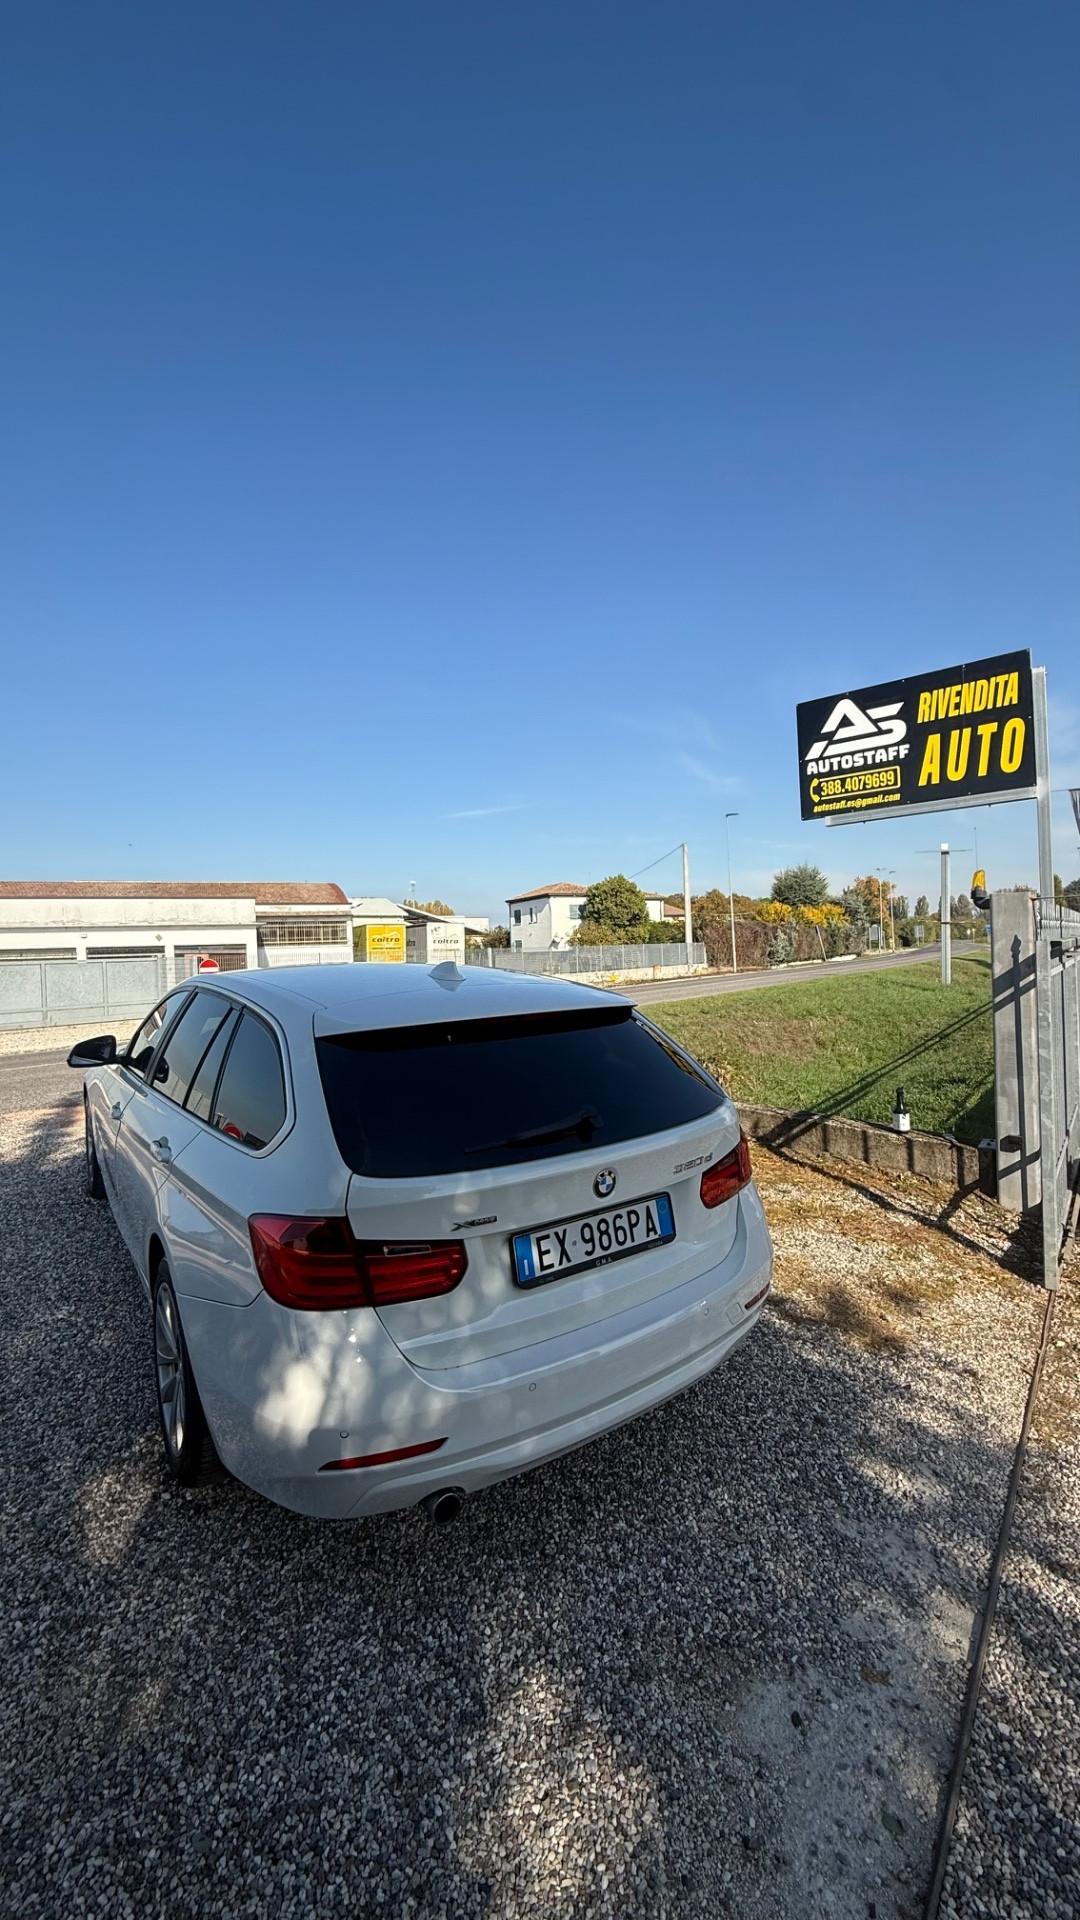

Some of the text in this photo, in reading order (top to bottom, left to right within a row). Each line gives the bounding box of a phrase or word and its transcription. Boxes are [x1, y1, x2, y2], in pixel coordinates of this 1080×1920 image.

[917, 671, 1019, 724] RIVENDITA
[806, 744, 910, 775] AUTOSTAFF
[918, 717, 1026, 787] AUTO
[820, 770, 895, 796] 388.4079699
